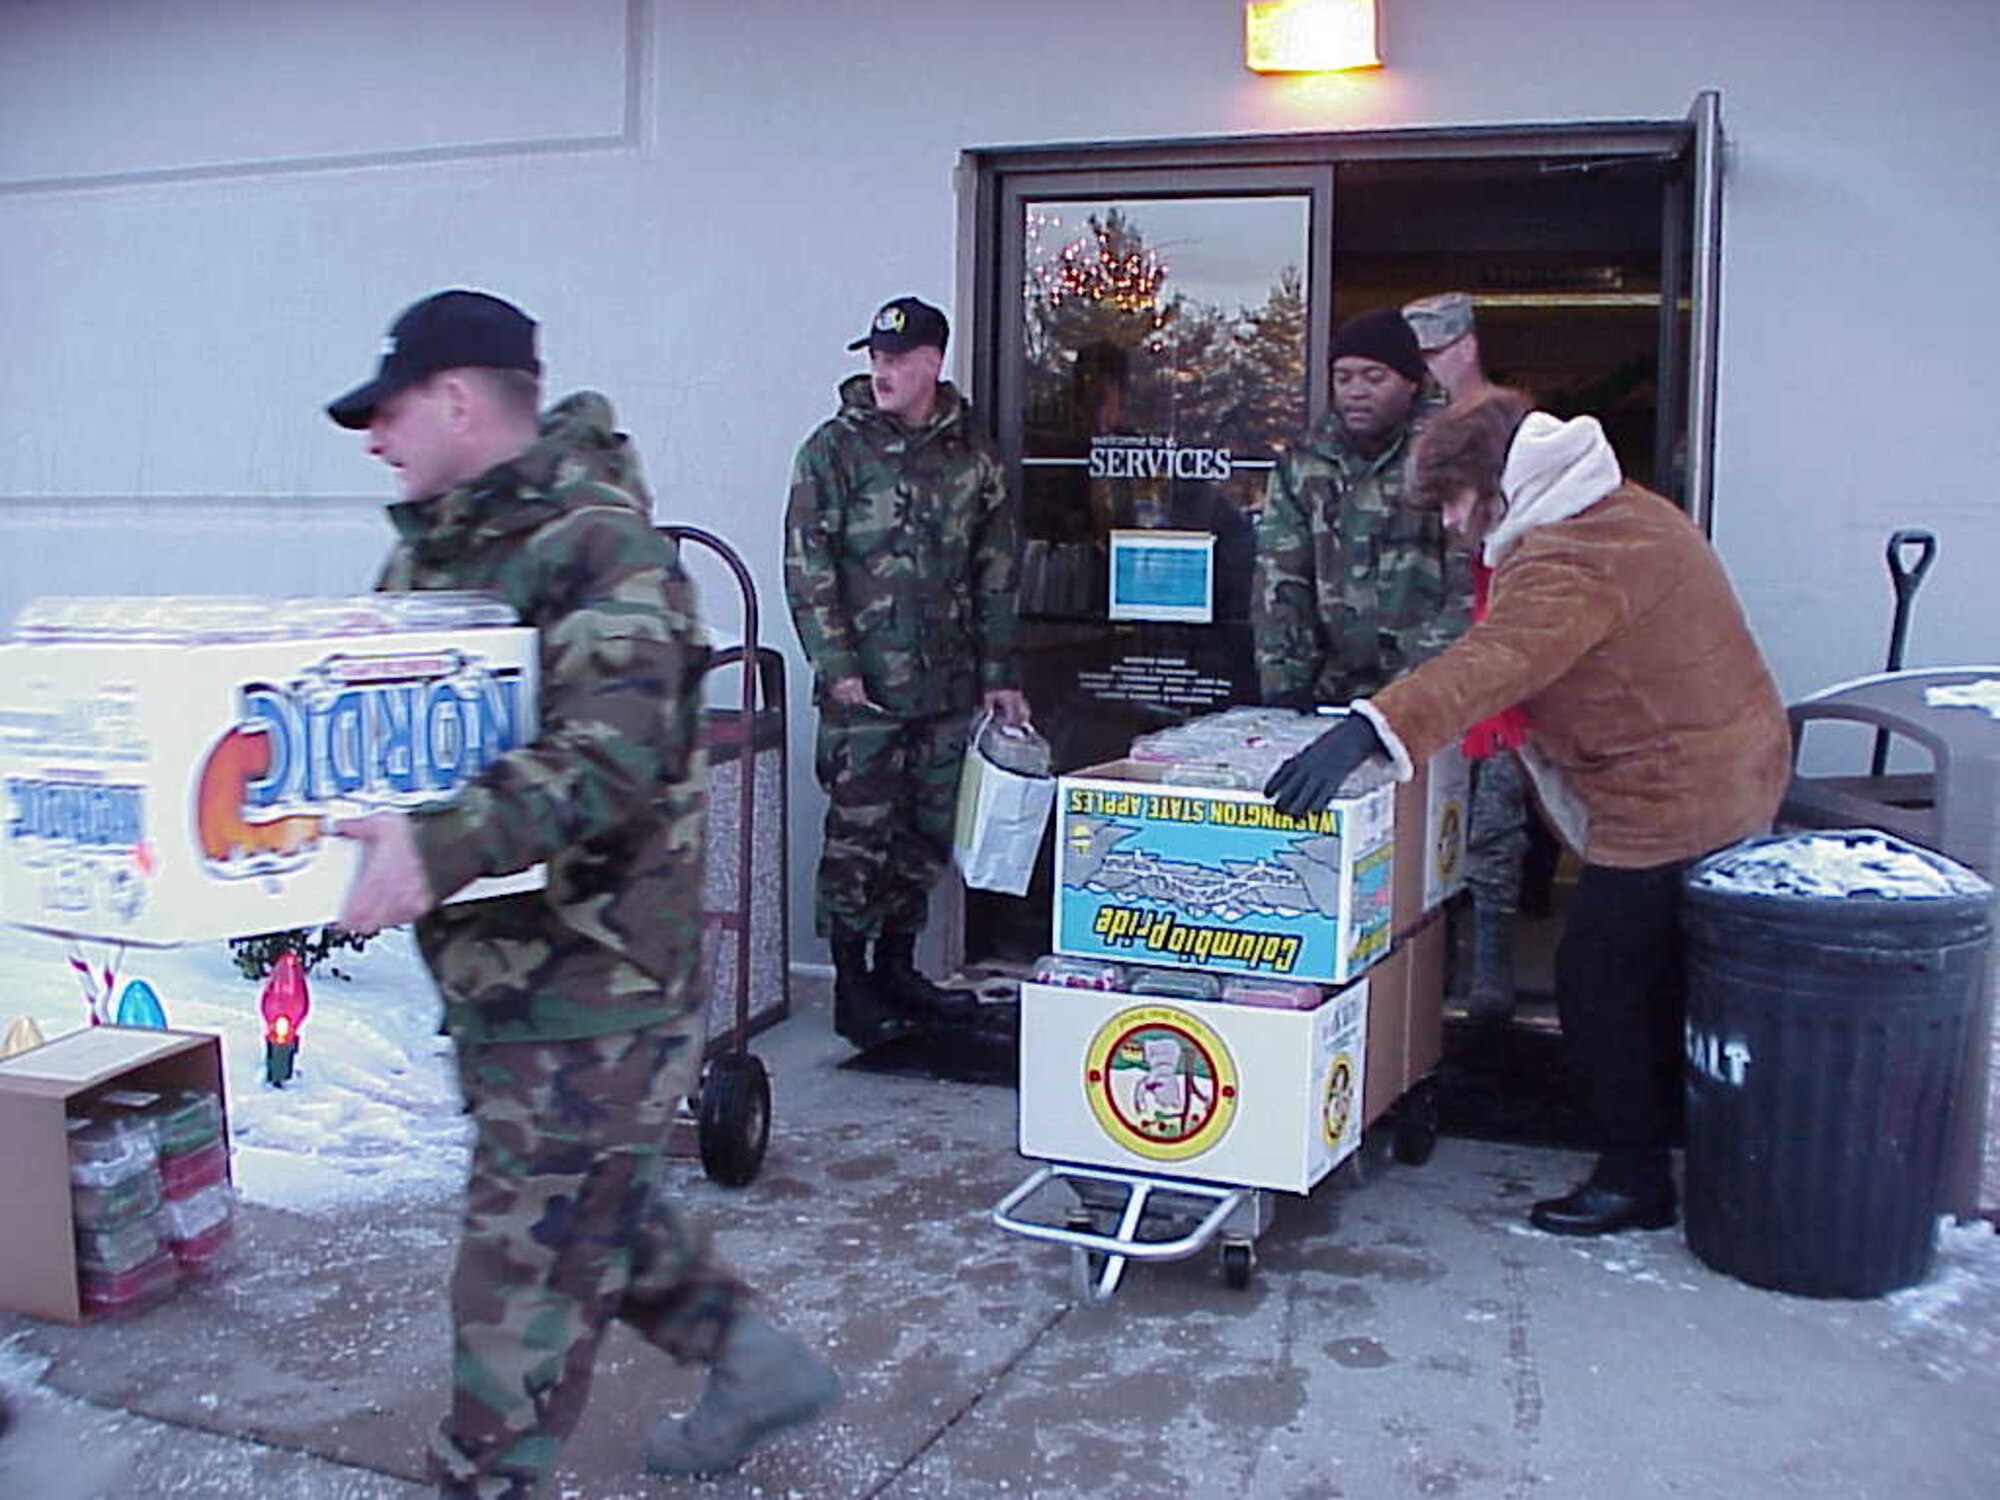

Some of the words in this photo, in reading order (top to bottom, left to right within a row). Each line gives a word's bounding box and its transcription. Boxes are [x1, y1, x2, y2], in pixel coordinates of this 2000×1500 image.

[1089, 448, 1231, 480] SERVICES
[236, 668, 522, 806] NORDIC
[1070, 789, 1139, 815] APPLES
[1149, 794, 1205, 822] STATE
